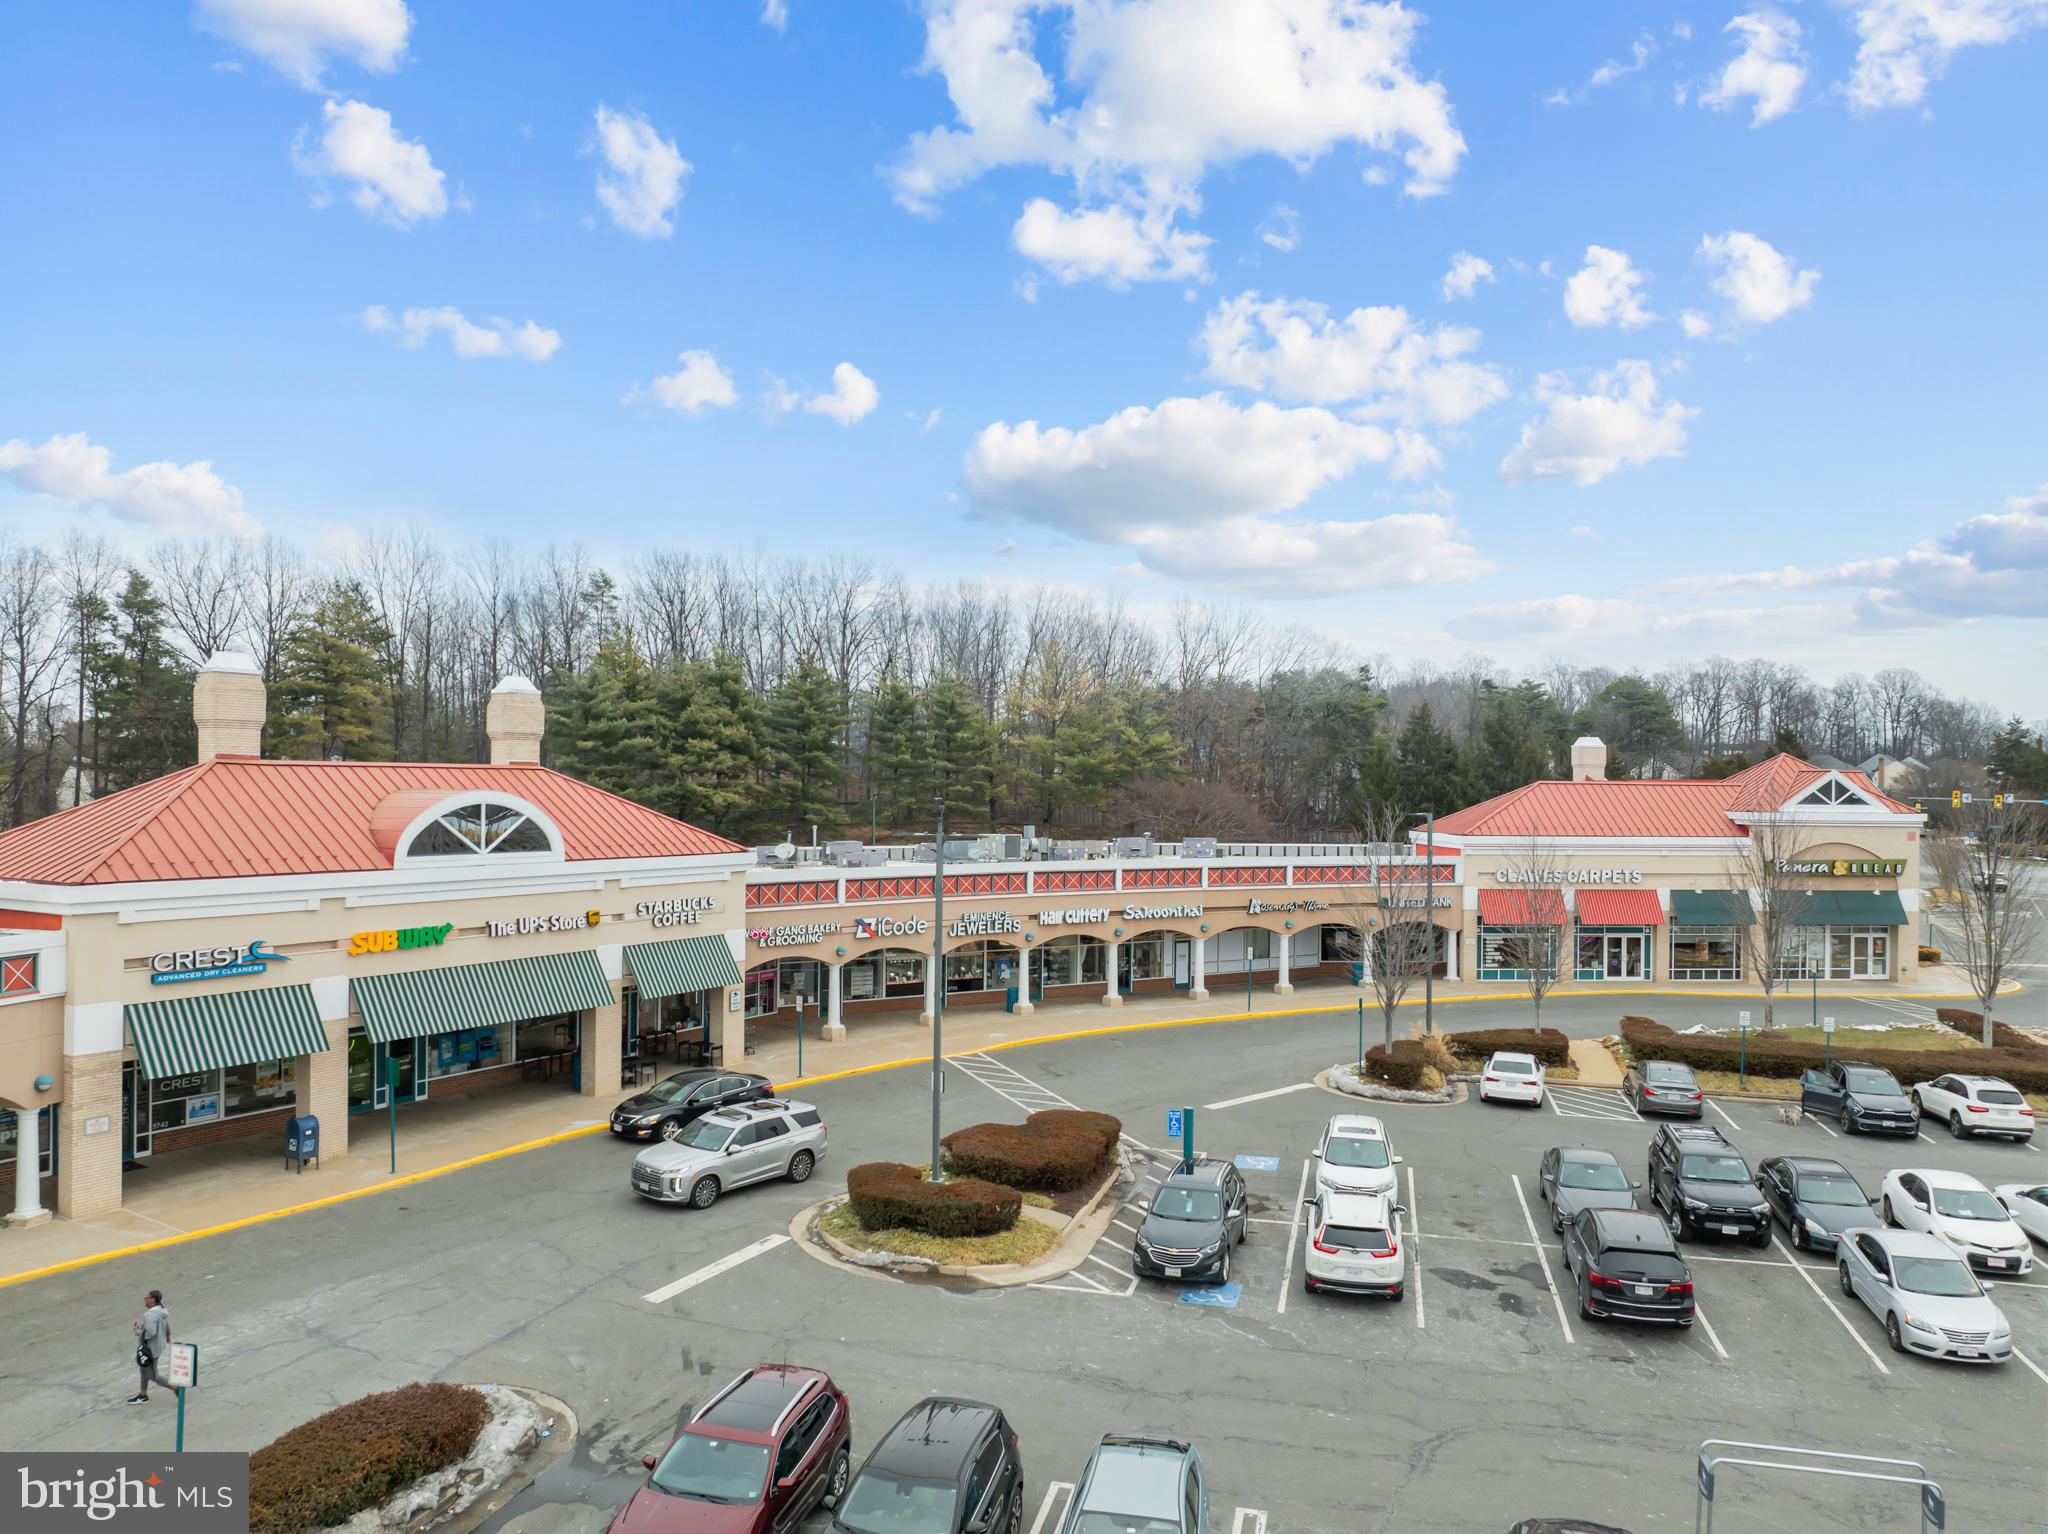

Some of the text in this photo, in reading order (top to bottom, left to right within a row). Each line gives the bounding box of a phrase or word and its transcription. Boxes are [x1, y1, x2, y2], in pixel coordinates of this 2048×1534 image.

[1774, 859, 1902, 873] Panera BREAD
[1496, 868, 1643, 884] CLAWES CARPETS
[636, 896, 717, 917] STARBUCKS
[1387, 897, 1426, 908] UNITED
[653, 911, 702, 928] COFFEE
[963, 911, 1011, 923] EMINENCE
[1038, 910, 1065, 926] Hair
[487, 915, 587, 937] The UPS Store
[775, 925, 806, 936] GANG
[807, 922, 841, 934] BAKERY
[877, 916, 929, 937] iCode
[948, 919, 1022, 937] JEWELERS
[348, 922, 454, 956] SUBWAY
[759, 933, 824, 948] & GROOMING
[152, 946, 248, 972] CREST
[157, 972, 202, 982] ADVANCED
[221, 965, 263, 976] CLEANERS
[160, 1074, 210, 1092] CREST
